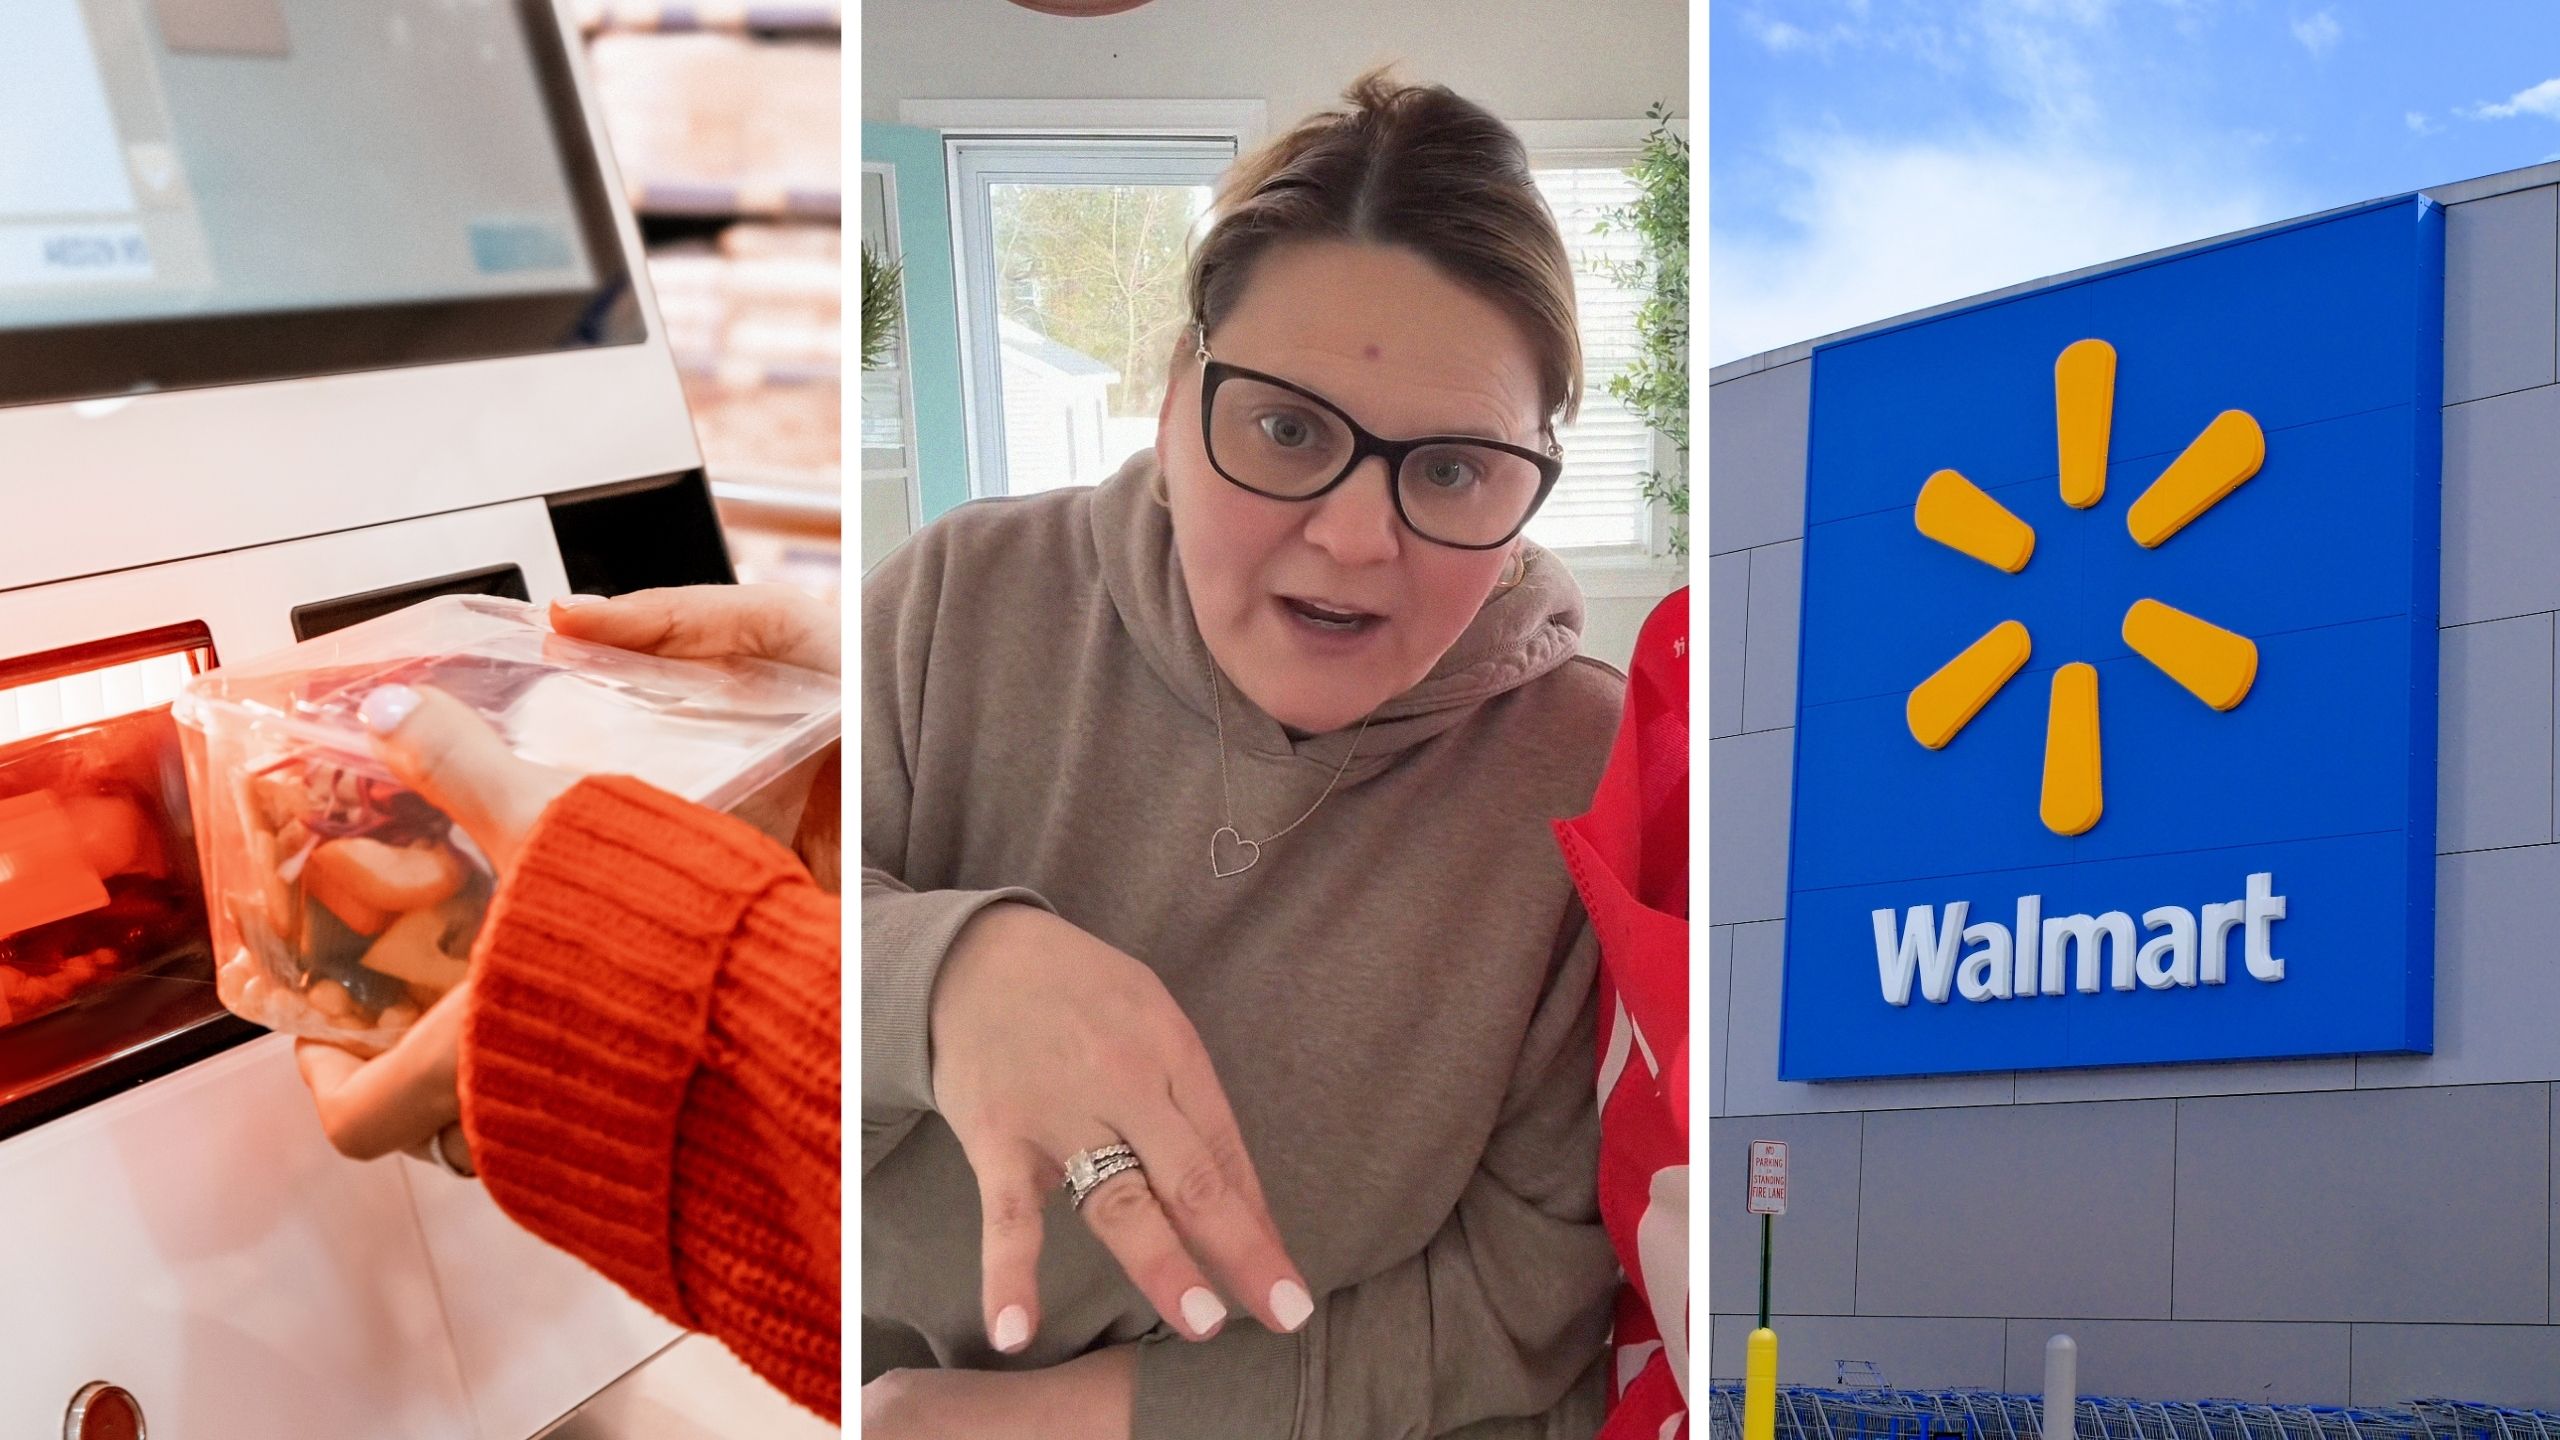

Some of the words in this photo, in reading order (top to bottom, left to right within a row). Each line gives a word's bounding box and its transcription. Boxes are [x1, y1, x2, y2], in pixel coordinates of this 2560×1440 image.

[1872, 872, 2286, 1006] Walmart
[1765, 1146, 1775, 1154] NO
[1755, 1157, 1783, 1168] PARKING
[1753, 1175, 1785, 1186] STANDING
[1752, 1186, 1766, 1198] FIRE
[1768, 1187, 1784, 1199] LANE
